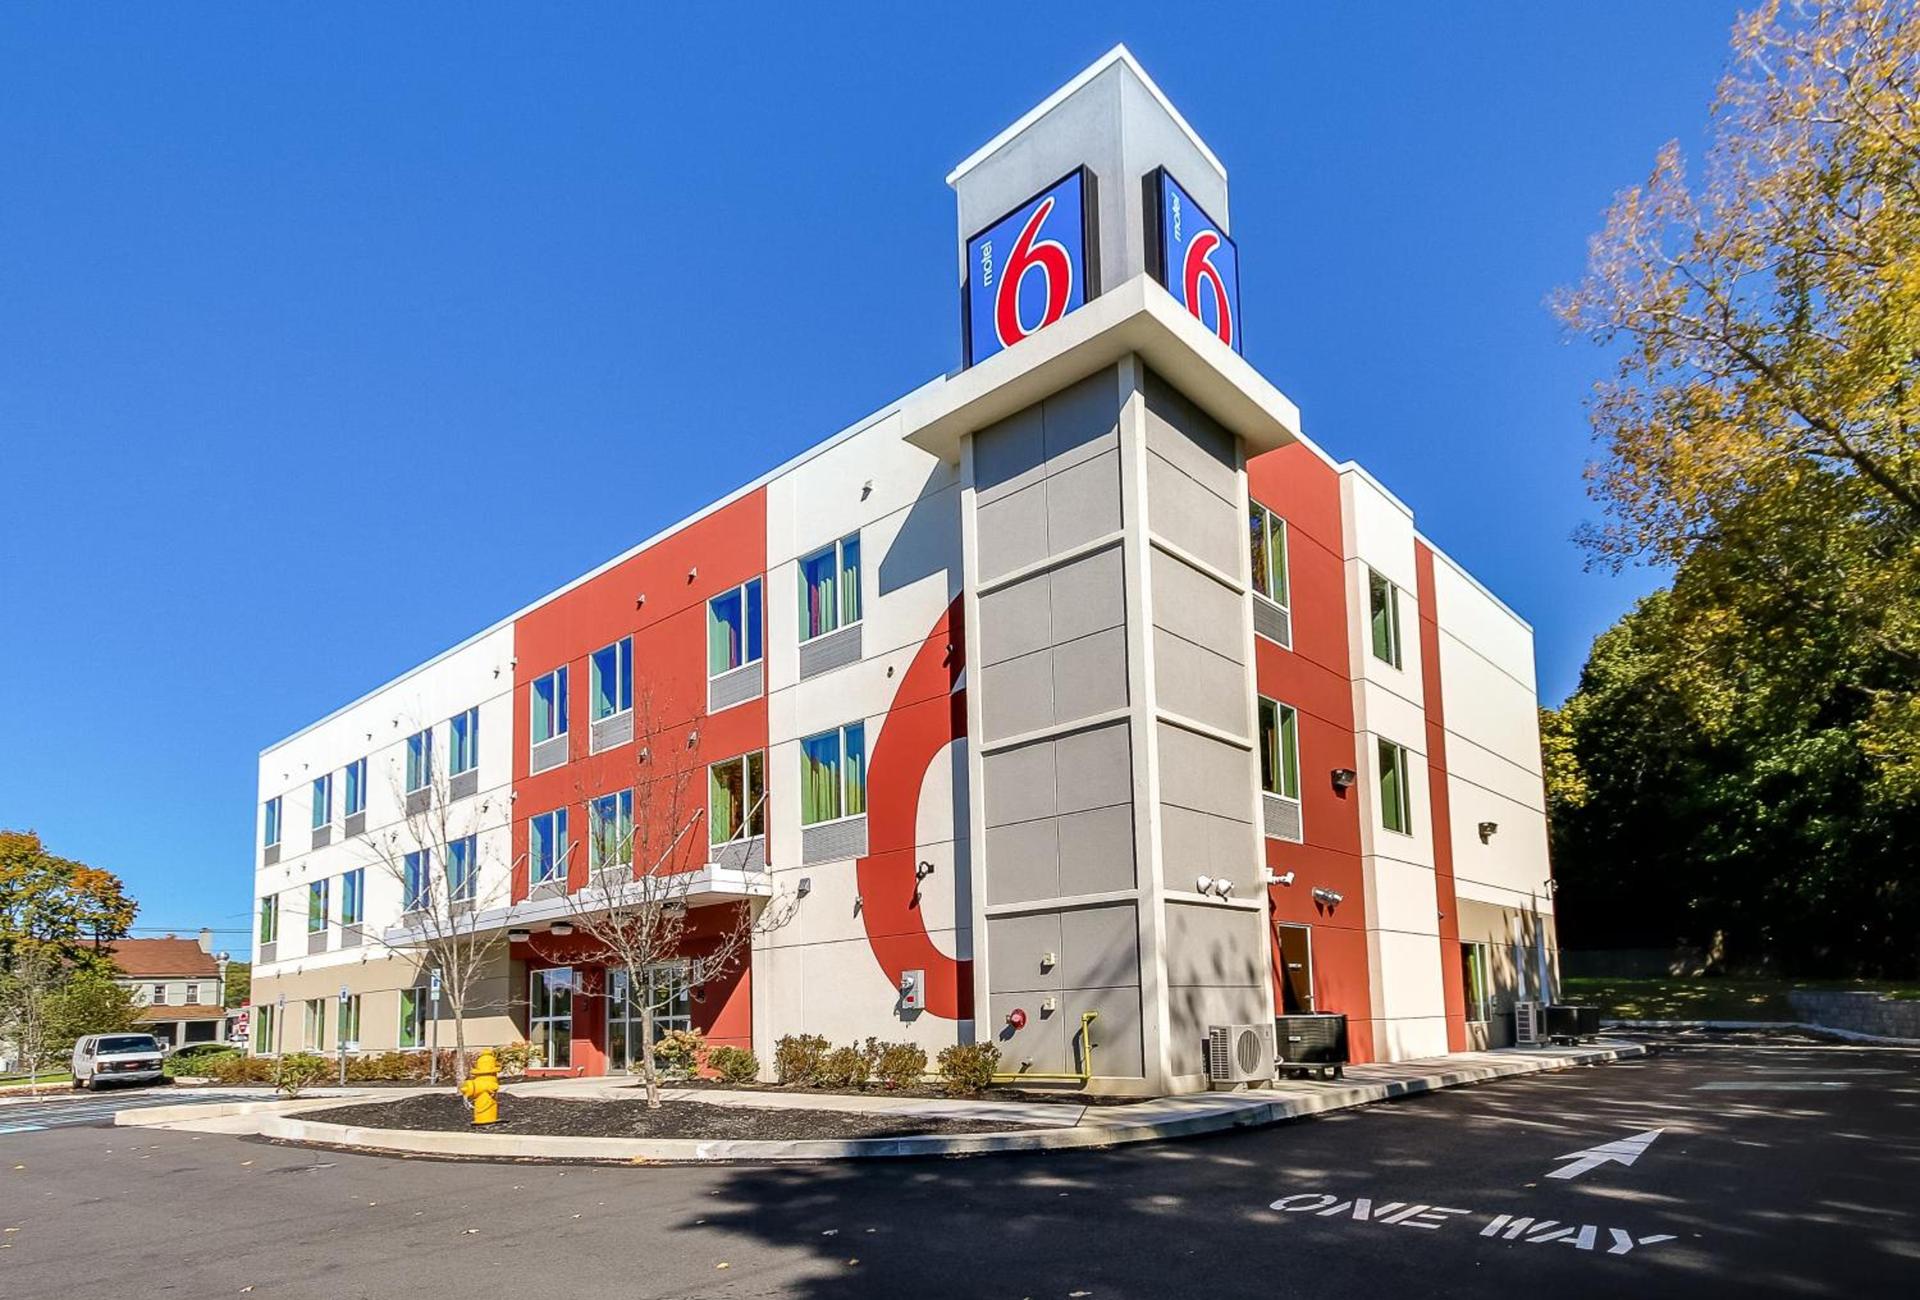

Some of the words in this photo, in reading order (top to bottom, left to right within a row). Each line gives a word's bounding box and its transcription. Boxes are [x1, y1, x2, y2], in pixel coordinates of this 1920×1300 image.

[980, 239, 993, 288] motel
[994, 196, 1073, 349] 6
[1171, 191, 1182, 243] motel
[1182, 229, 1233, 349] 6
[1269, 1193, 1472, 1229] ONE
[1479, 1214, 1678, 1255] WAY
